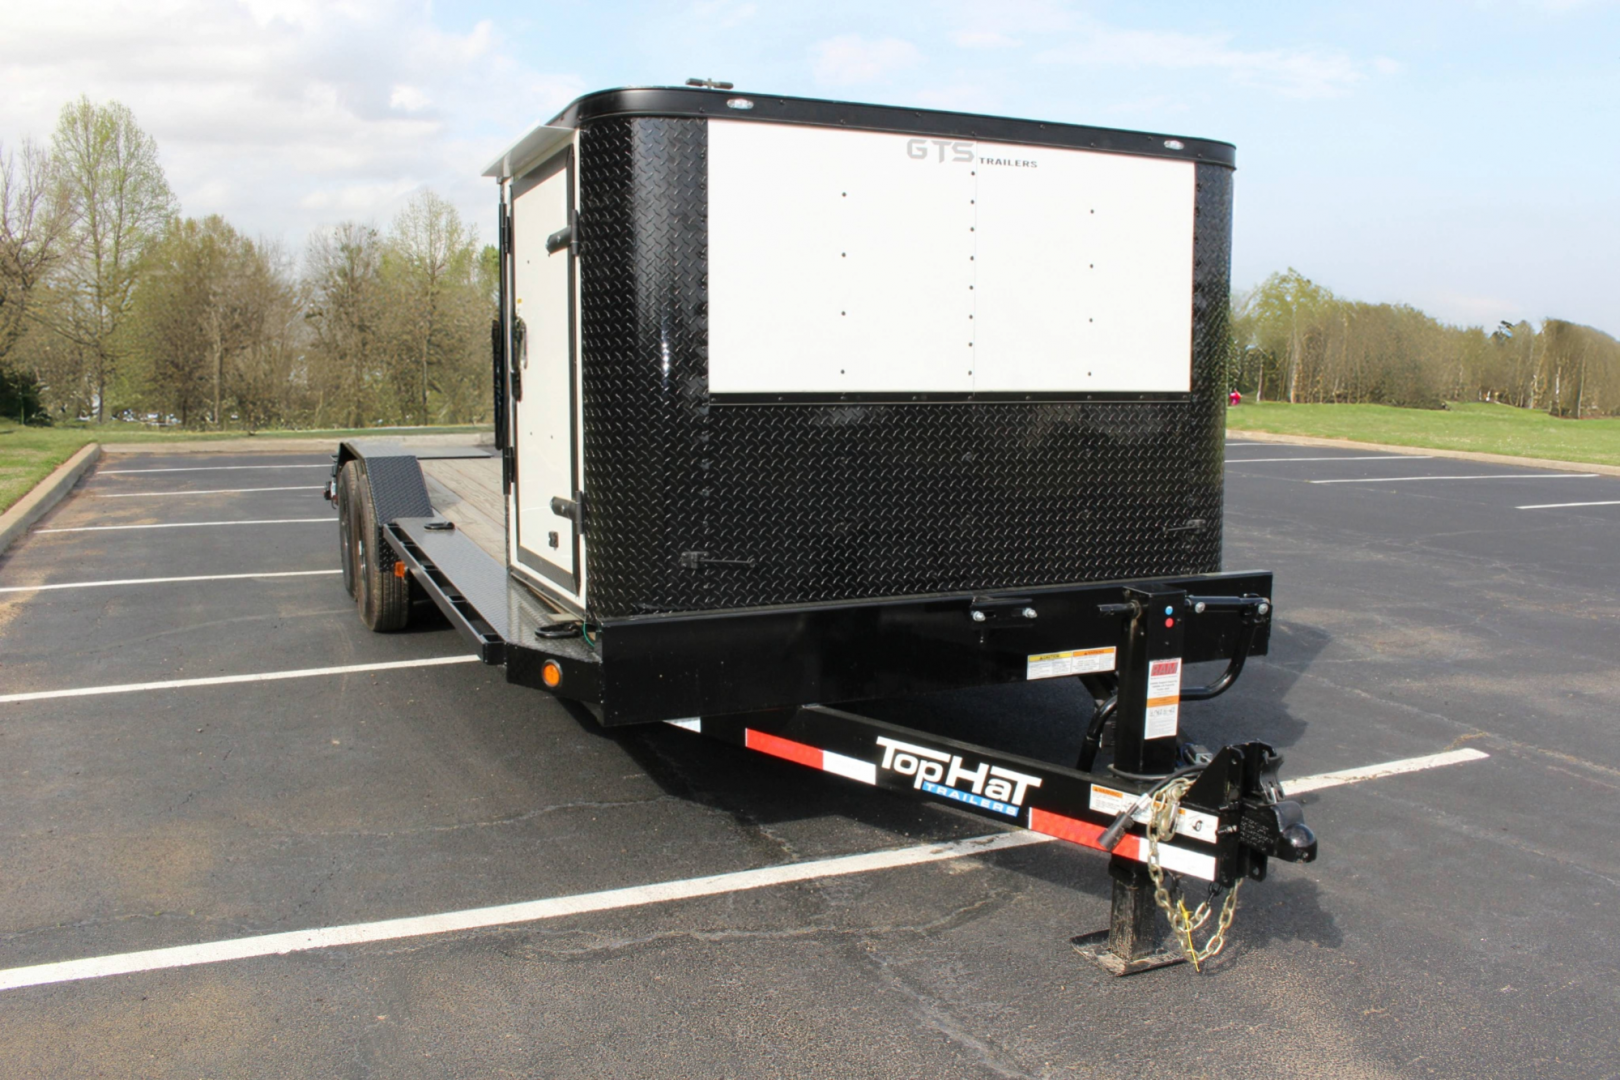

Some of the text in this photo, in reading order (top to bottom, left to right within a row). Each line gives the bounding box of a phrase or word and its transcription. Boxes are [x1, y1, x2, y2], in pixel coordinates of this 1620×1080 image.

[907, 138, 1038, 168] GTS TRAILERS
[1151, 661, 1179, 676] RAM
[924, 781, 1019, 817] TRAILERS
